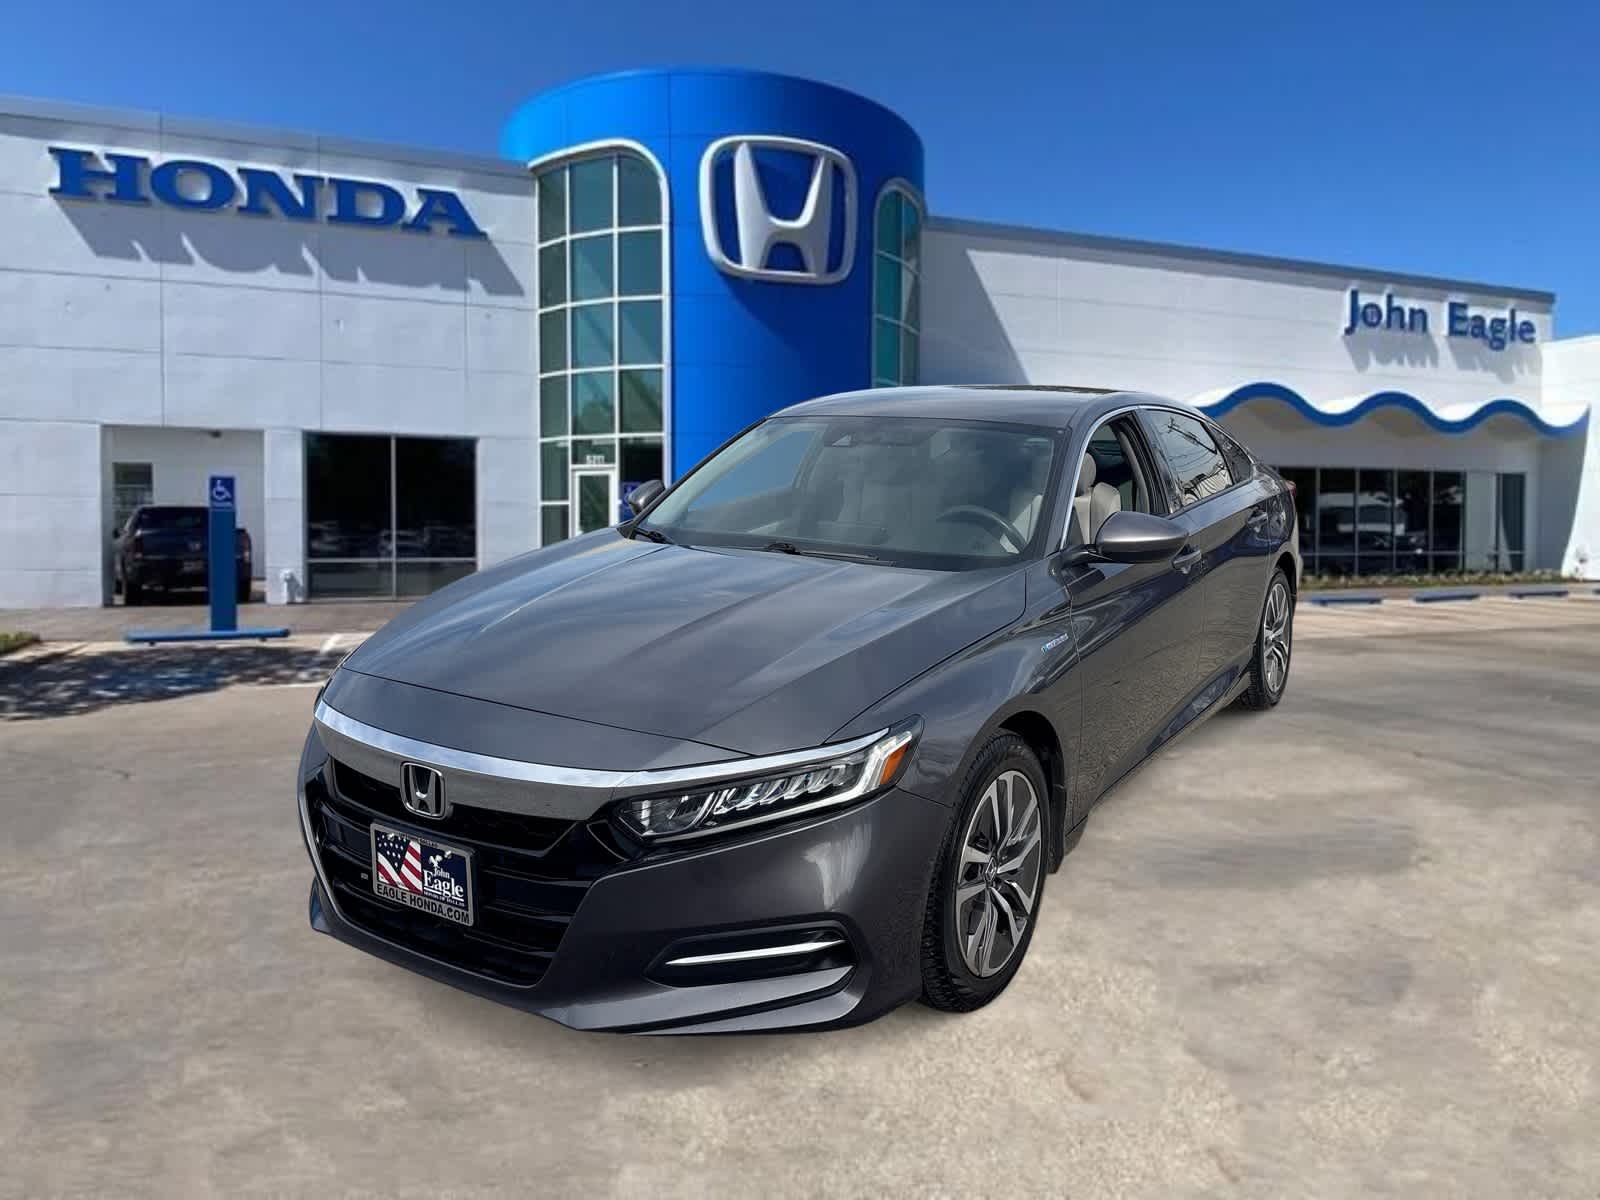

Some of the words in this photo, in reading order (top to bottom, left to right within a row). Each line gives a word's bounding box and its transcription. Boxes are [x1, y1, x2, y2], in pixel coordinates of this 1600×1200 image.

[48, 146, 488, 240] HONDA
[1344, 289, 1428, 336] John
[1448, 302, 1536, 351] Eagle
[423, 869, 464, 898] Eagle
[433, 866, 450, 879] John
[377, 884, 407, 903] EAGLE
